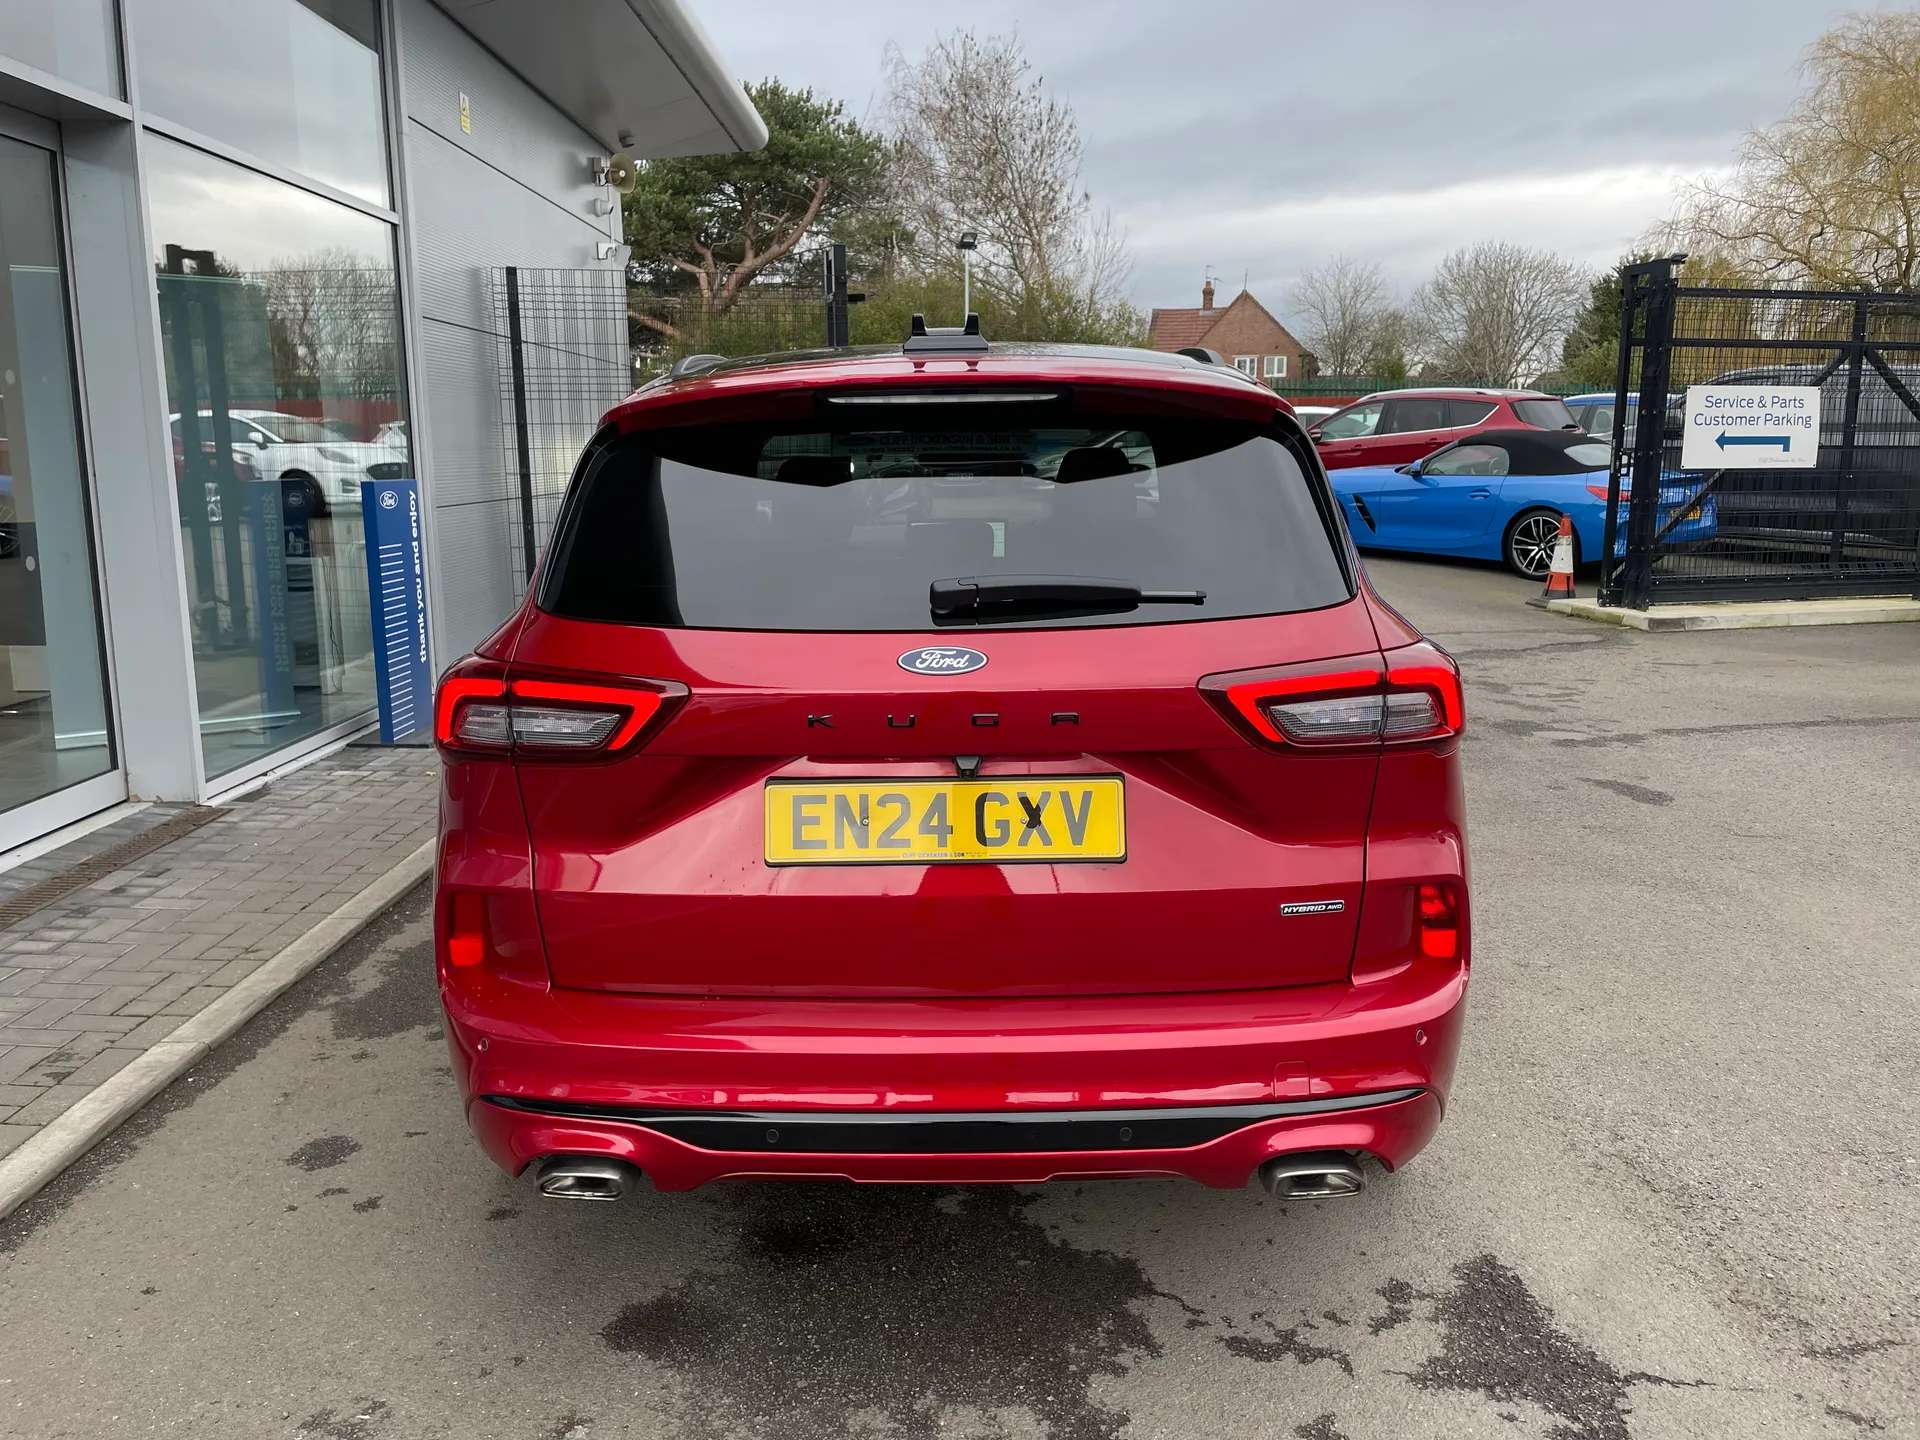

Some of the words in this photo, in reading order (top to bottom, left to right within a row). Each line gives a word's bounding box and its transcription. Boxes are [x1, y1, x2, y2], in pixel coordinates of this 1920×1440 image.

[1704, 395, 1754, 409] Service
[1757, 395, 1768, 409] &
[1771, 395, 1805, 409] Parts
[1694, 413, 1761, 426] Customer
[1763, 412, 1812, 429] Parking
[409, 490, 418, 538] enjoy
[411, 541, 421, 573] and
[415, 577, 425, 610] you
[417, 614, 427, 663] thank
[915, 649, 969, 670] Ford
[807, 712, 1081, 729] KUGA
[791, 792, 954, 850] EN24
[974, 790, 1095, 848] GXV
[1283, 905, 1326, 914] HYBRID
